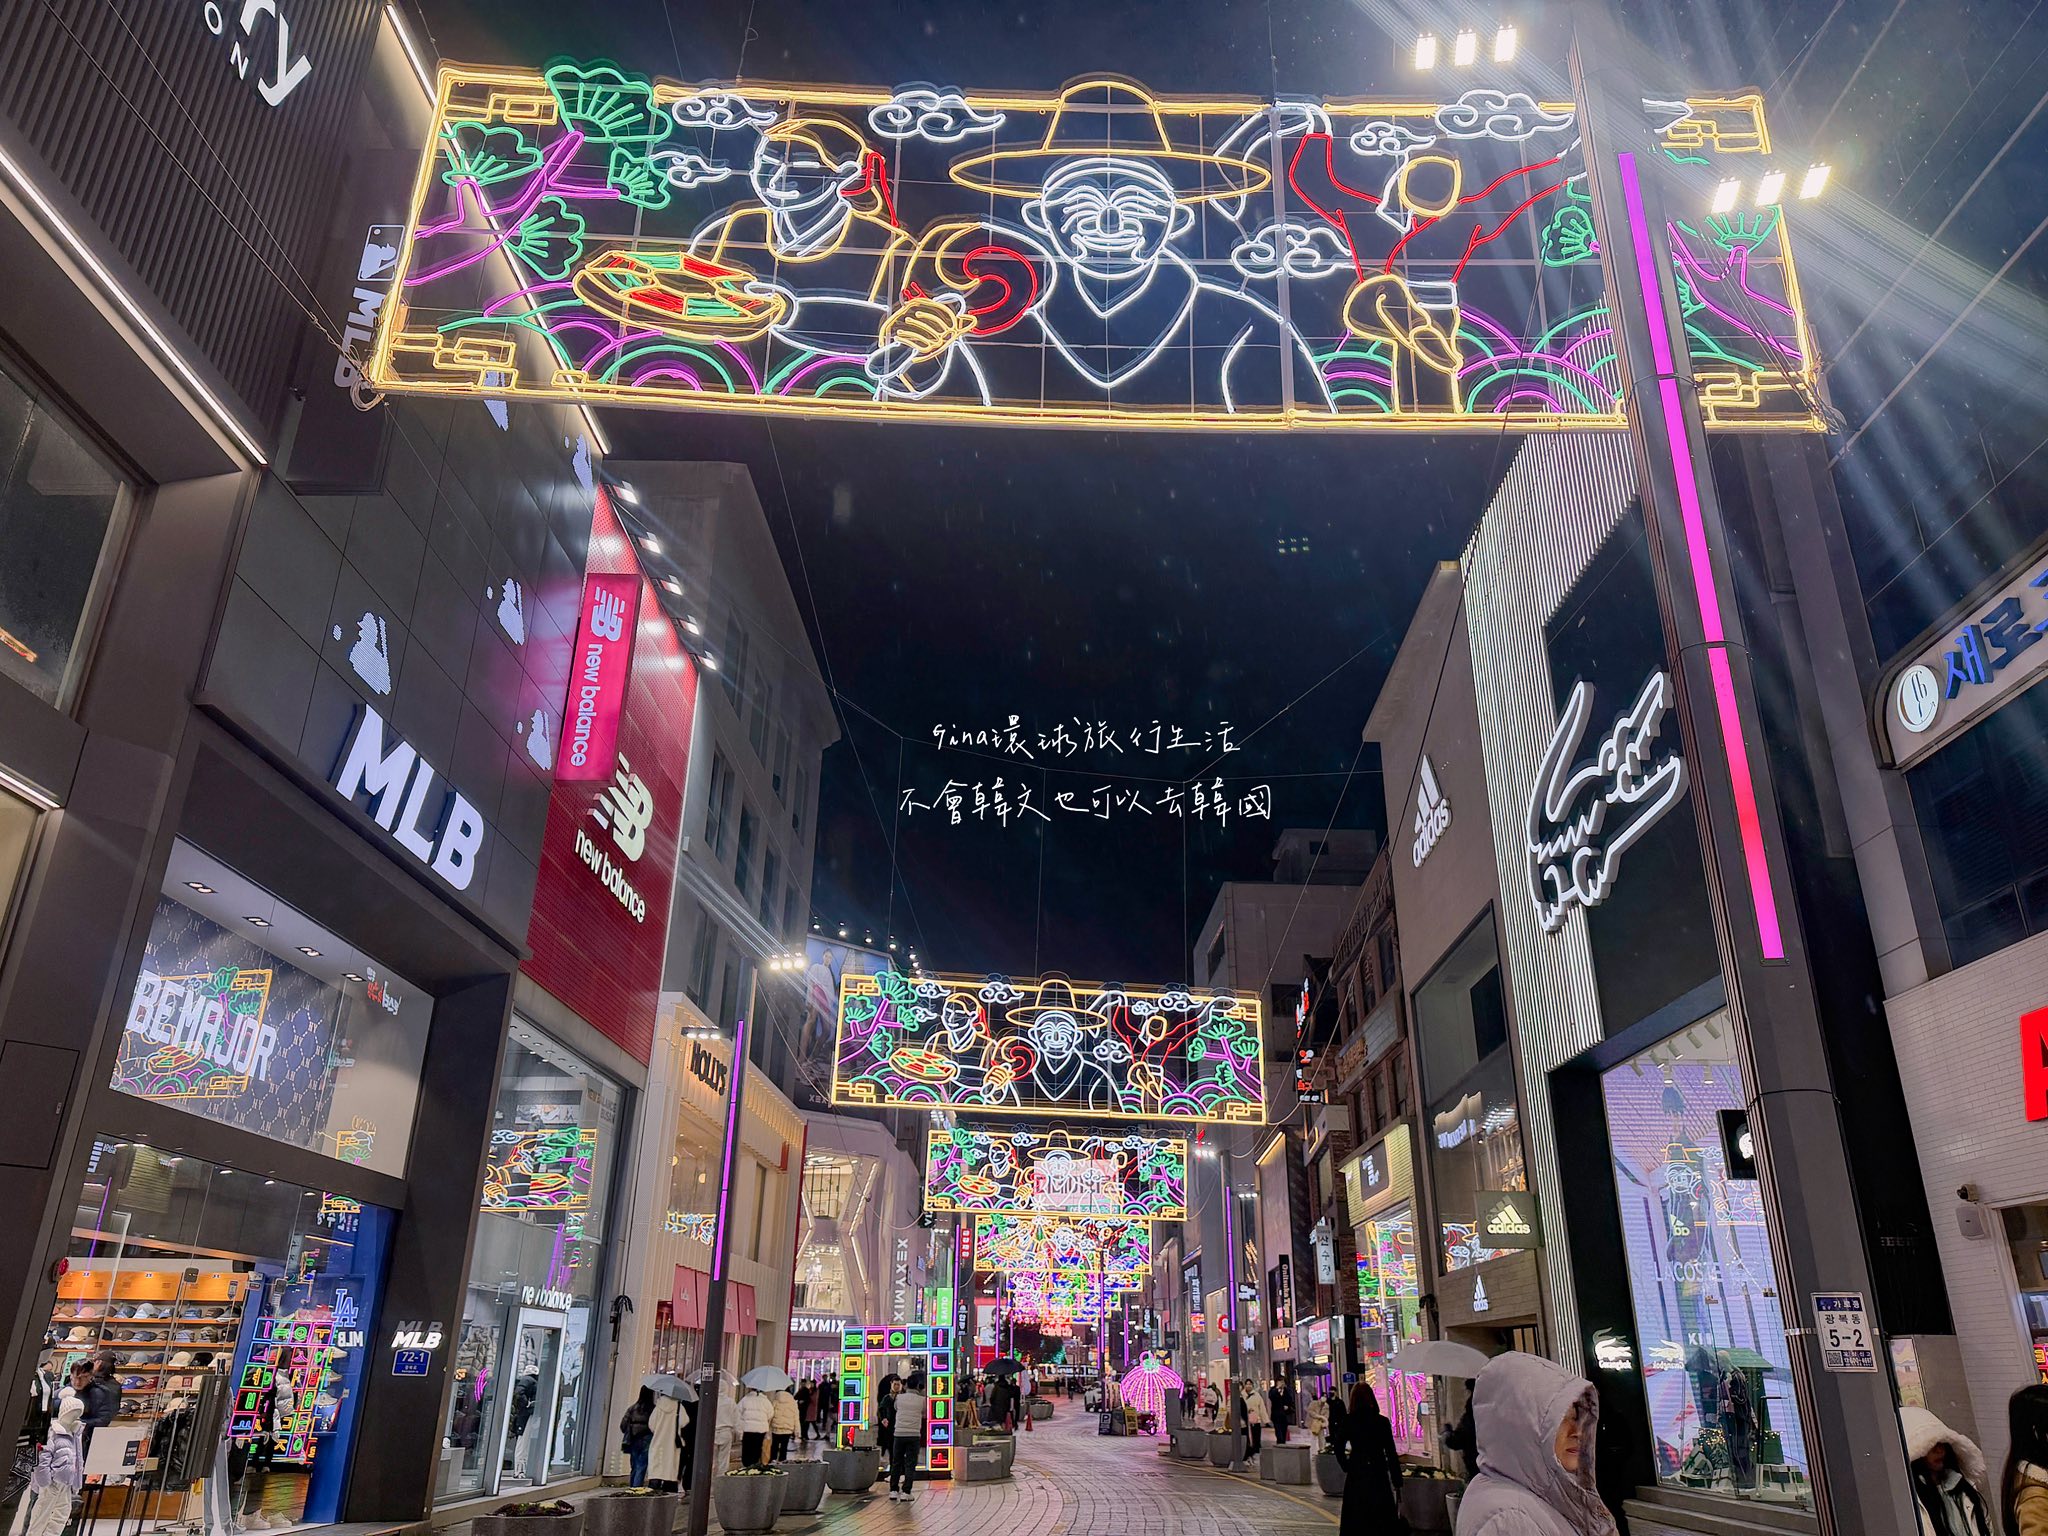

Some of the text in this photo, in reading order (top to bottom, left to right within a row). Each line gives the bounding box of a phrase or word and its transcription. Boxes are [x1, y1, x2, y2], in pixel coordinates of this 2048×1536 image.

[1943, 568, 2048, 700] 세로
[571, 643, 603, 767] new balance
[335, 704, 484, 891] MLB
[1412, 798, 1452, 868] adidas
[575, 828, 646, 923] new balance
[1486, 1219, 1531, 1235] adidas
[893, 1238, 909, 1322] XEXYMIX
[391, 1331, 443, 1349] MLB
[1825, 1313, 1861, 1325] 광복동
[1829, 1328, 1865, 1348] 5-2
[402, 1351, 425, 1363] 72-1
